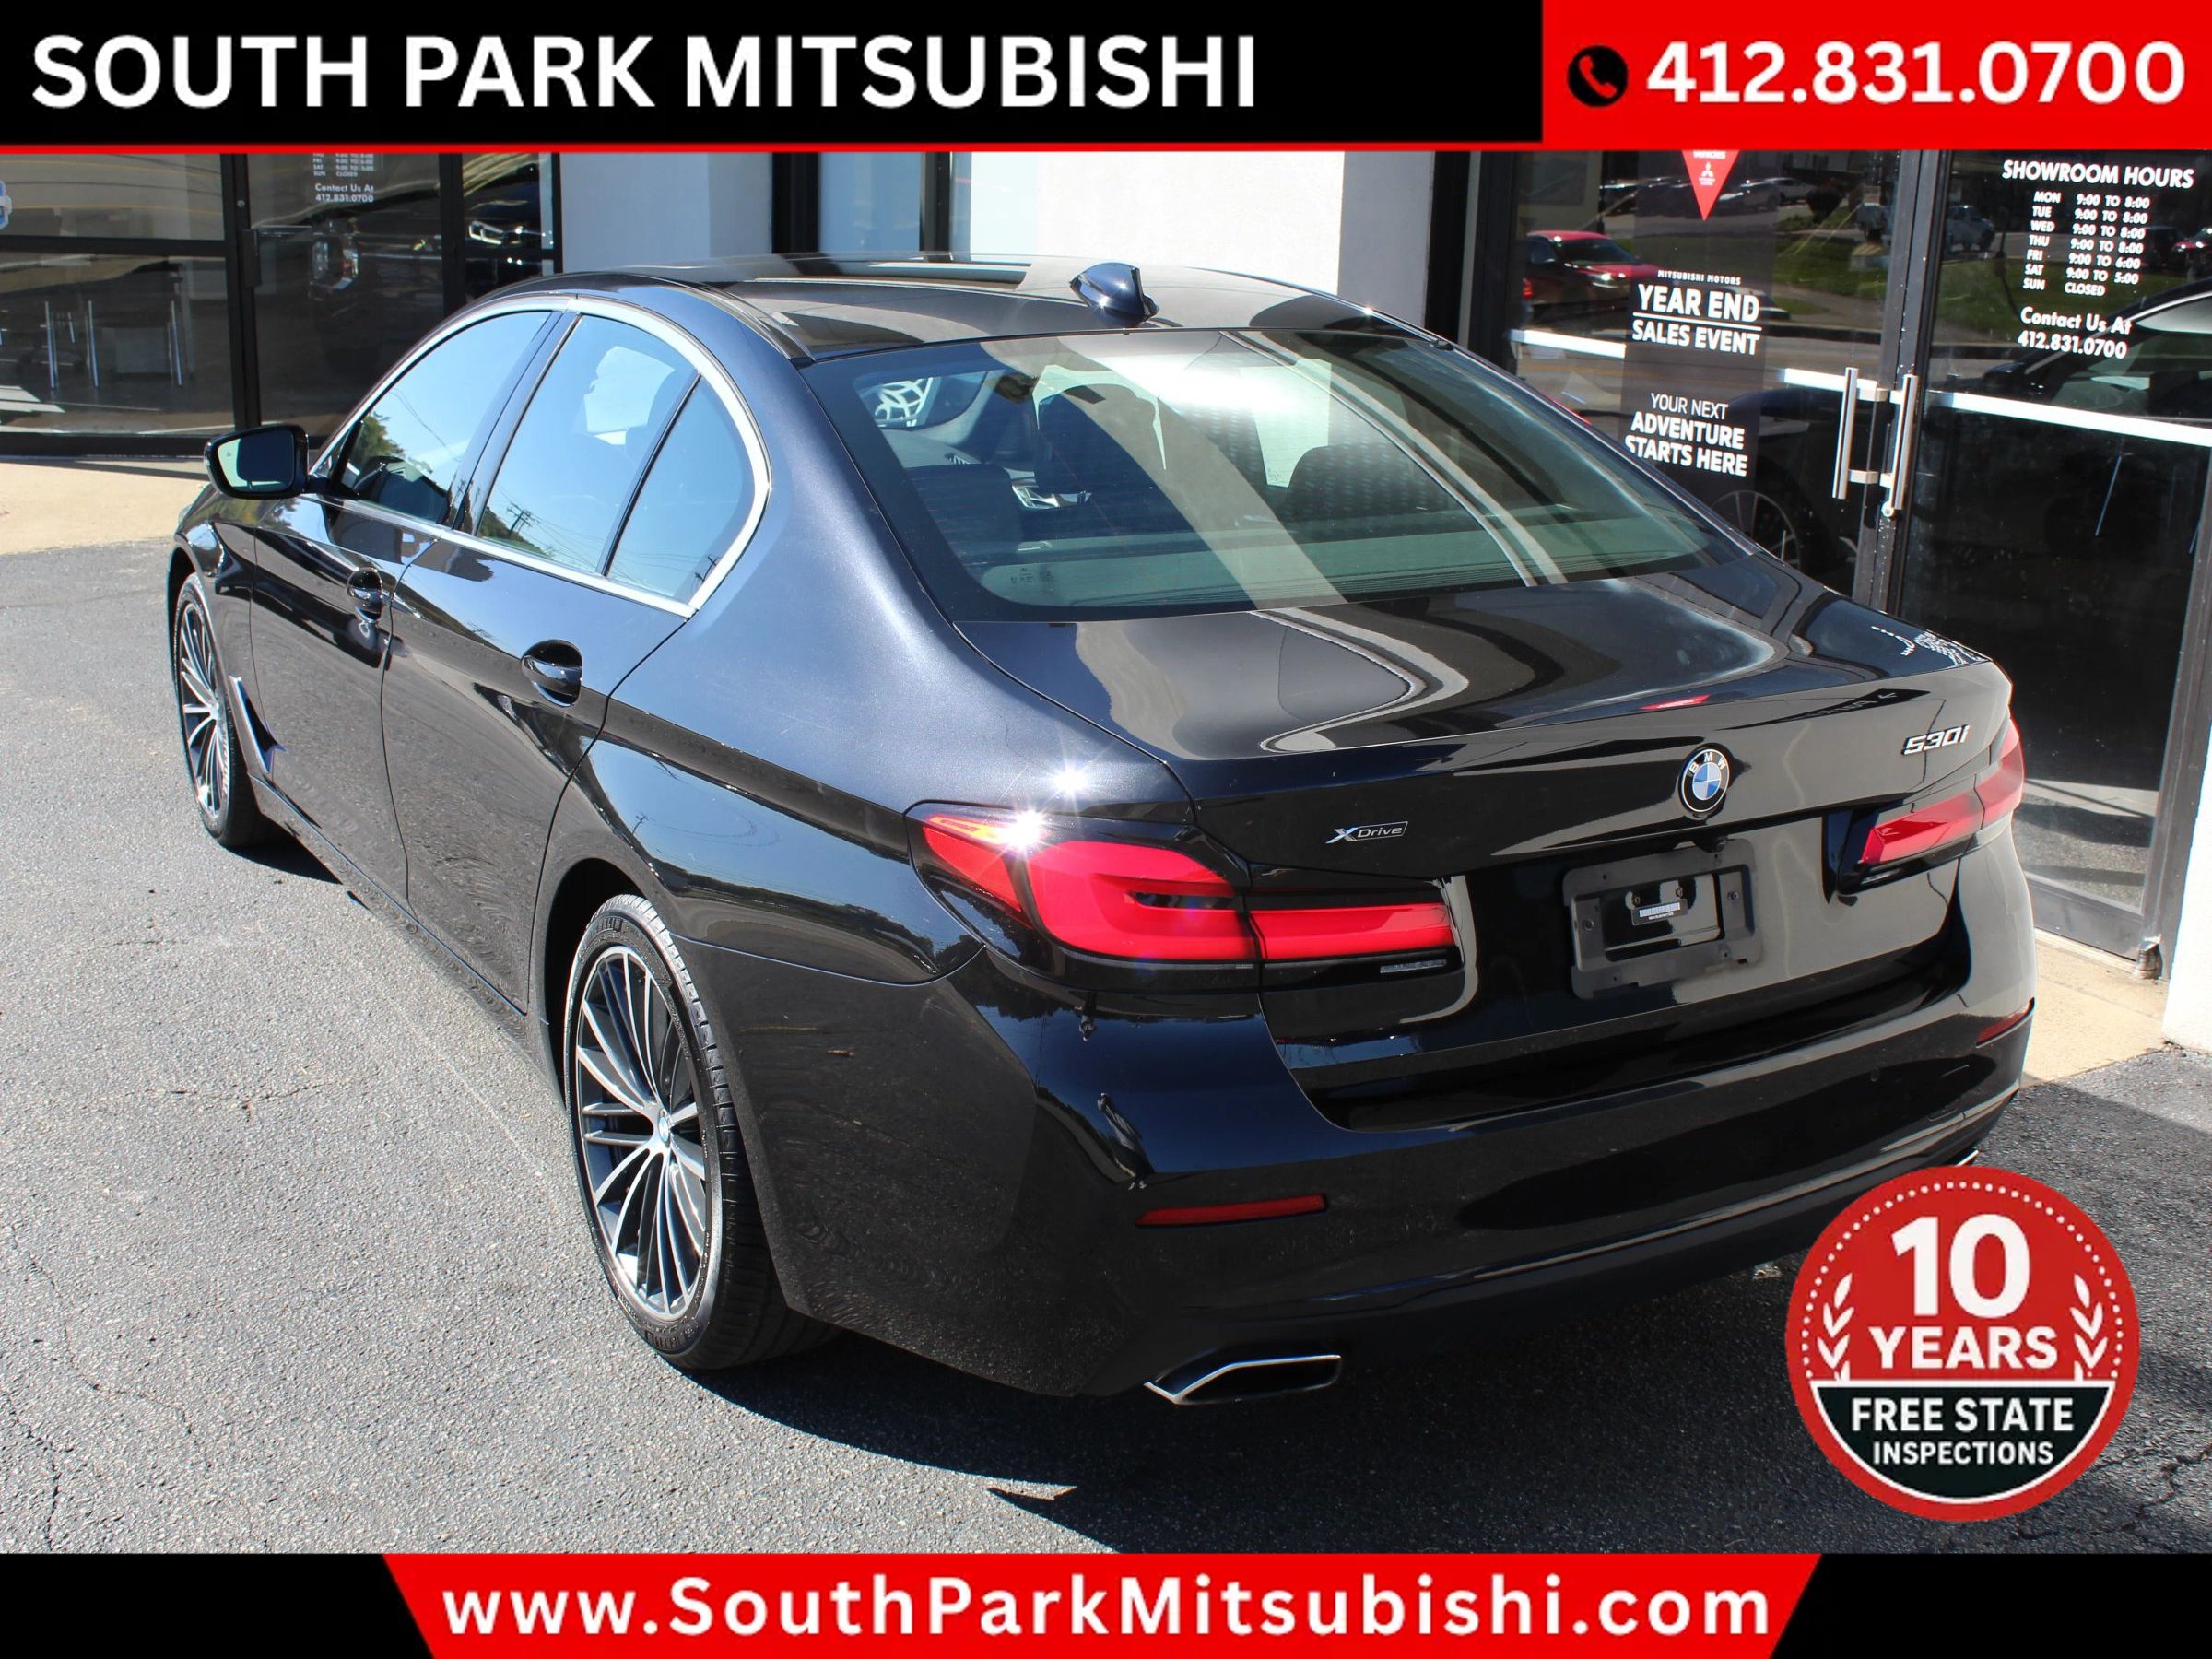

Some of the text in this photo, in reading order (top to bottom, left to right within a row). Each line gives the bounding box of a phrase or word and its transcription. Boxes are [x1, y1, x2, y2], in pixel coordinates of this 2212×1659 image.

[2002, 159, 2195, 189] SHOWROOM HOURS
[315, 183, 374, 194] Contact Us At
[315, 194, 374, 203] 412.831.0700
[2033, 191, 2150, 209] MON 9:00 TO 8:00
[2032, 206, 2148, 224] TUE 9:00 TO 8:00
[2030, 220, 2146, 240] WED 9:00 TO 8:00
[2029, 234, 2144, 254] THU 9:00 TO 8:00
[2027, 249, 2141, 270] FRI 9:00 TO 6:00
[1657, 269, 1741, 286] MITSUBISHI MOTORS
[2025, 264, 2139, 285] SAT 9:00 TO 5:00
[2023, 277, 2106, 297] SUN CLOSED
[1638, 283, 1760, 323] YEAR END
[2020, 306, 2132, 335] Contact Us At
[1631, 319, 1760, 356] SALES EVENT
[2017, 330, 2128, 359] 412.831.0700
[1650, 393, 1729, 420] YOUR NEXT
[1630, 411, 1746, 450] ADVENTURE
[1625, 434, 1748, 477] STARTS HERE
[1688, 751, 1727, 774] BMW
